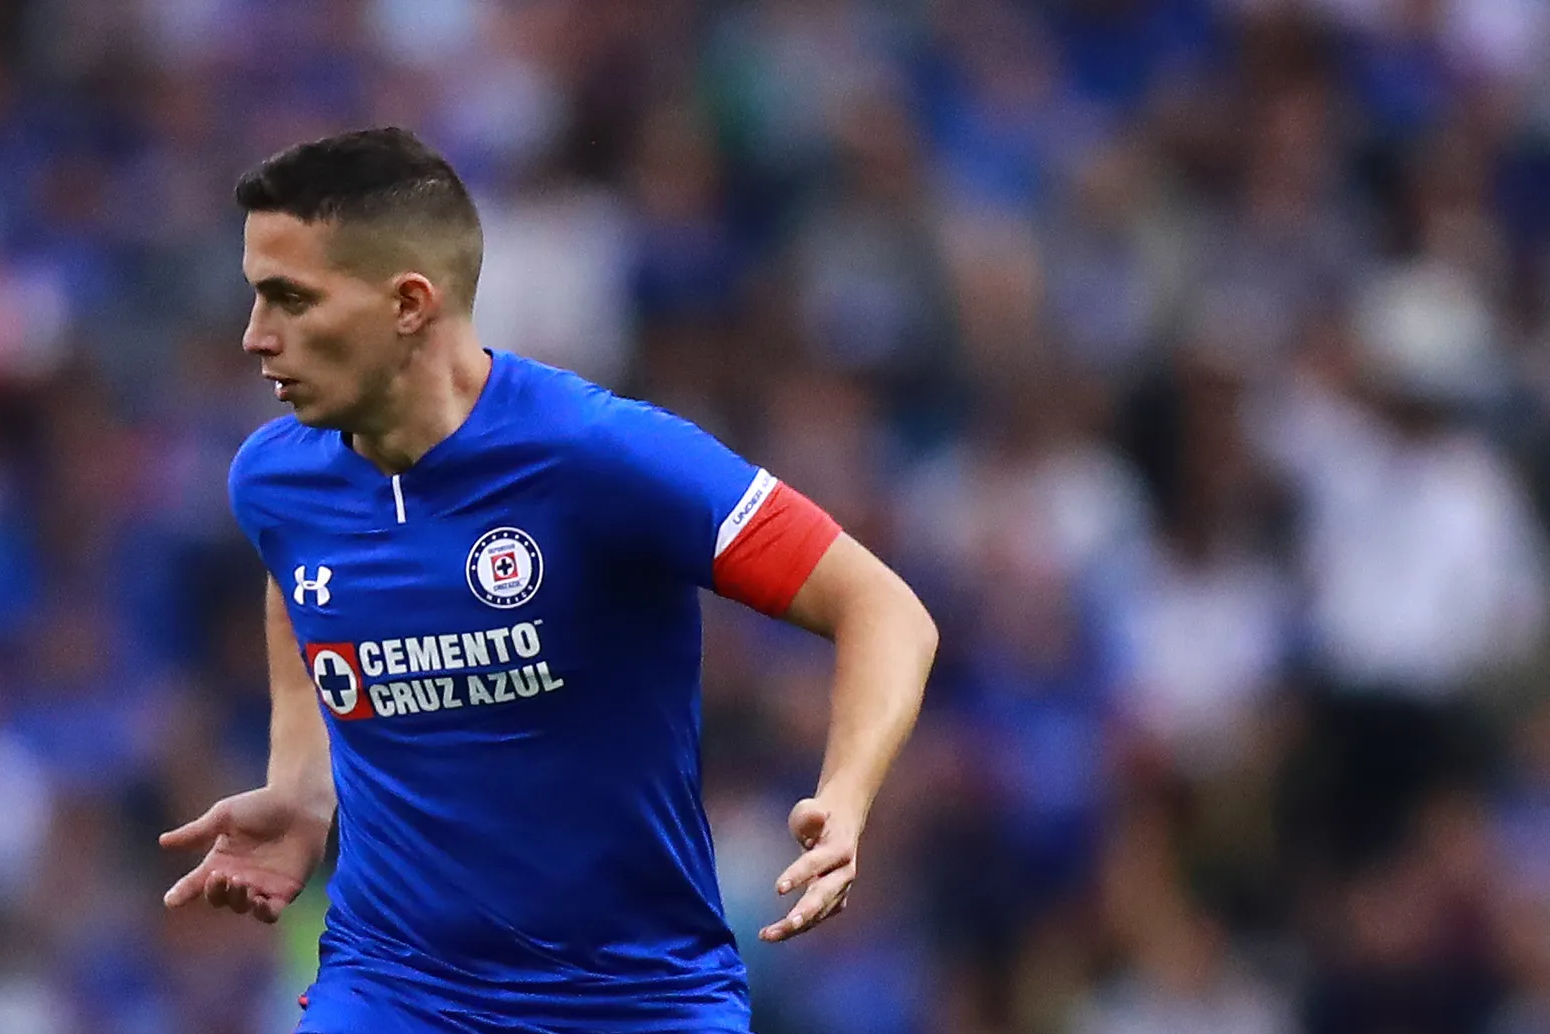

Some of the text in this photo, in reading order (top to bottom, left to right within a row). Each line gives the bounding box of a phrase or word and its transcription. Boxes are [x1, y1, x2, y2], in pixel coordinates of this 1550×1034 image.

[359, 621, 541, 677] CEMENTO
[369, 661, 564, 718] CRUZ AZUL
